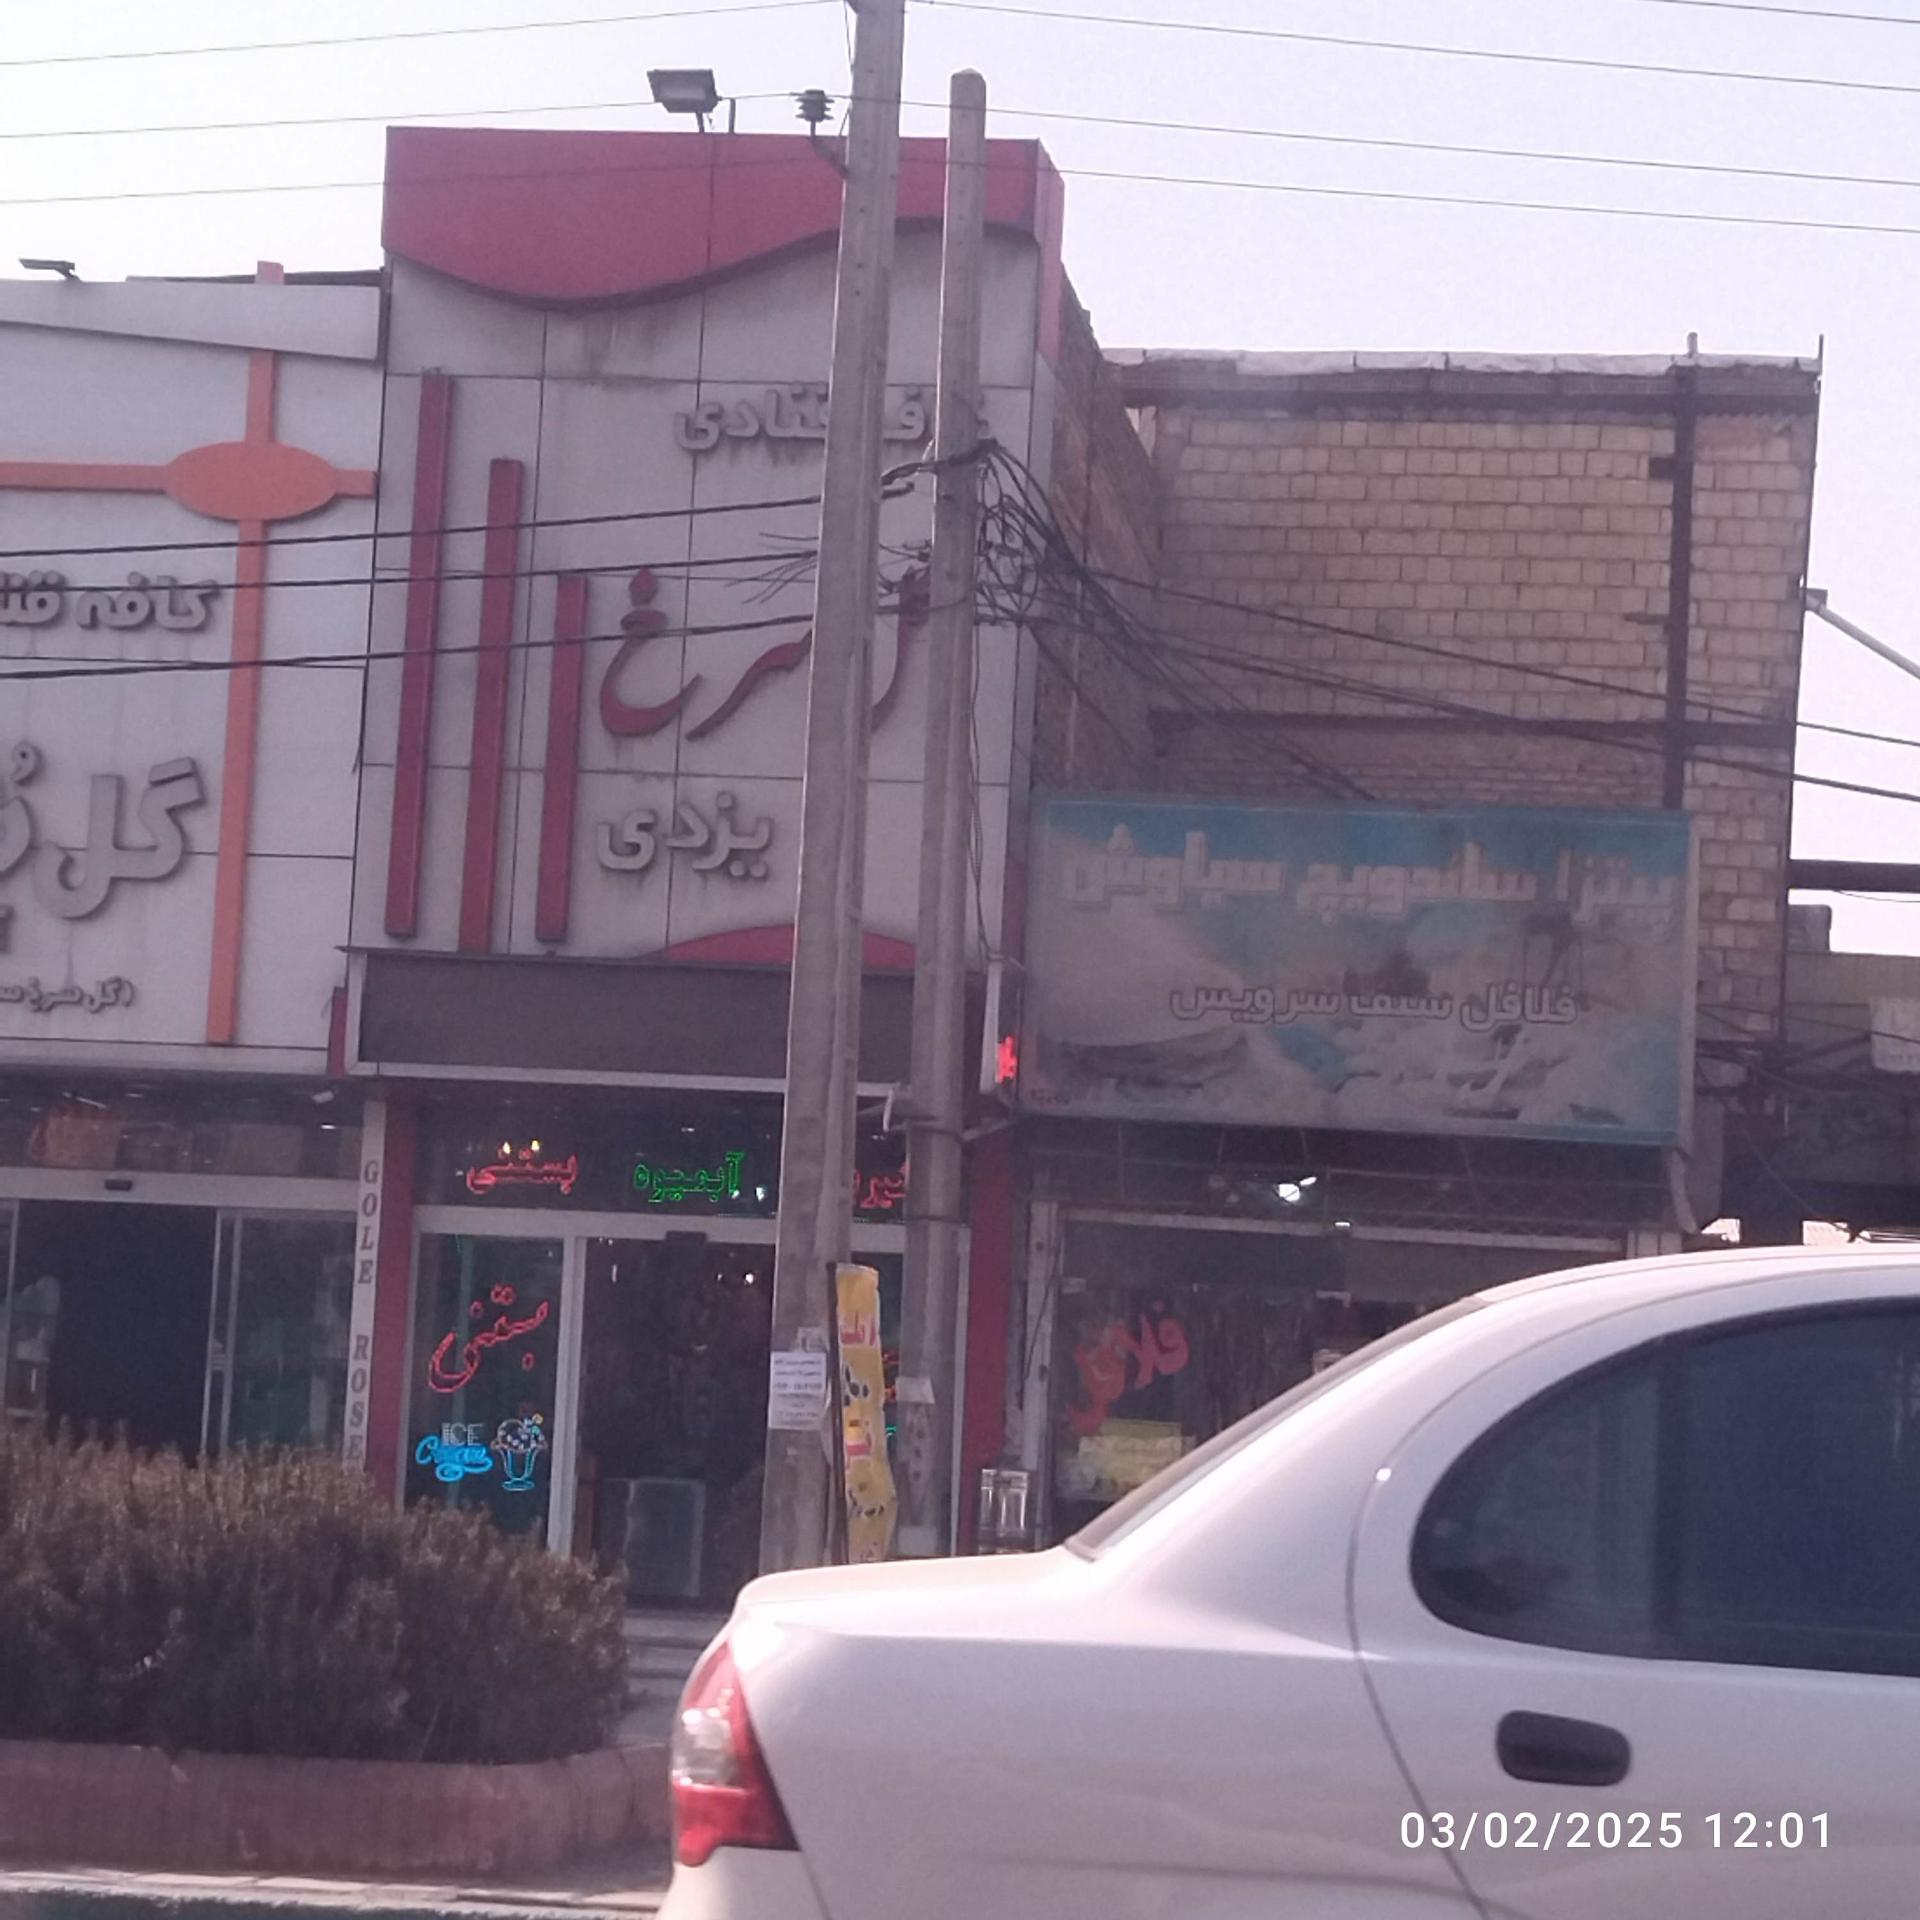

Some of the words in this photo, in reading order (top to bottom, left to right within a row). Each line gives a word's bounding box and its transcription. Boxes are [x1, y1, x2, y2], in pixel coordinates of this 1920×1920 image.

[676, 387, 829, 451] نادی
[77, 571, 221, 631] کافه
[33, 756, 205, 921] گل
[600, 791, 774, 881] یزدی
[1169, 986, 1343, 1025] سرویس
[1459, 982, 1578, 1033] فلافل
[466, 1148, 577, 1195] بستنی
[633, 1152, 746, 1203] آبمیوه
[357, 1160, 380, 1285] GOLE
[428, 1285, 549, 1393] بستنی
[440, 1422, 483, 1447] ICE
